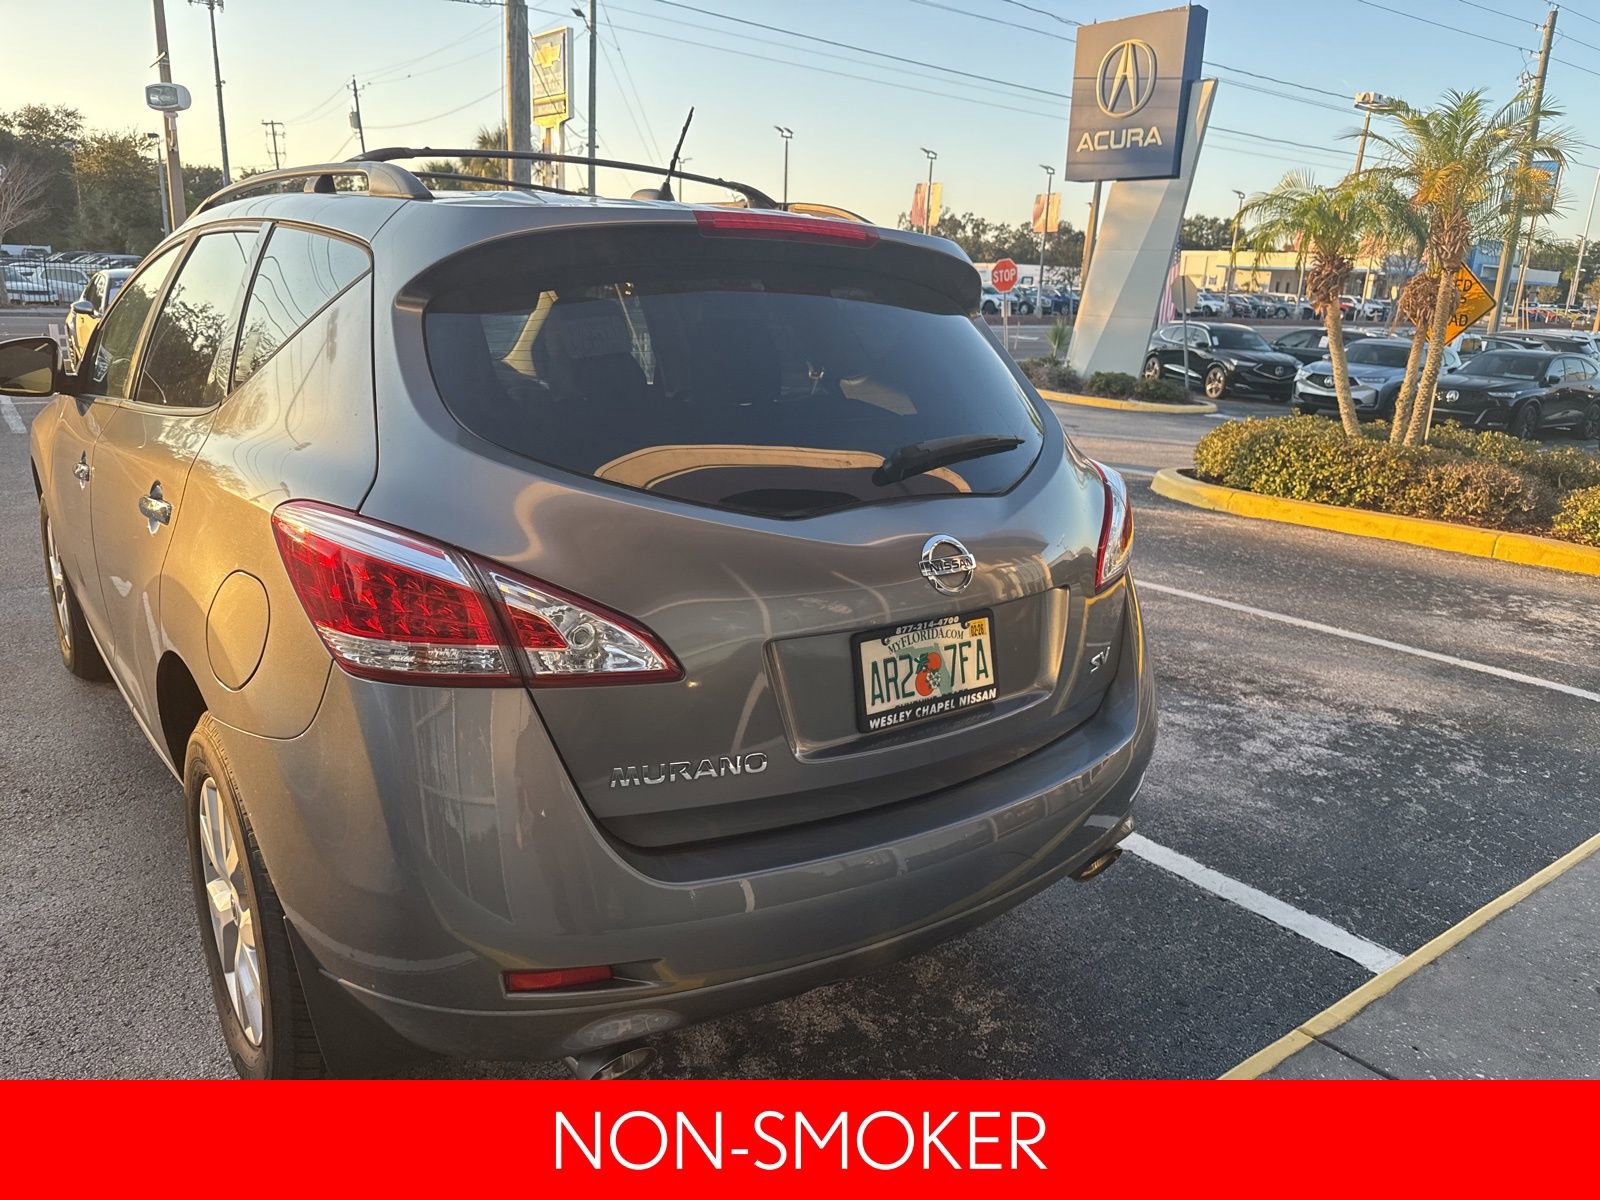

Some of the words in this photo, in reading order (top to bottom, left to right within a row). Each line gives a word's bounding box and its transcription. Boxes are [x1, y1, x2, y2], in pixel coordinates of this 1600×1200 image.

[1076, 126, 1162, 153] ACURA
[993, 268, 1016, 284] STOP
[930, 558, 973, 573] NISSAN
[895, 616, 960, 635] 877-214-4700
[887, 628, 964, 655] MYFLORIDA.COM
[869, 709, 912, 730] WESLEY
[915, 699, 956, 718] CHAPEL
[959, 688, 997, 707] NISSAN
[610, 752, 768, 788] MURANO
